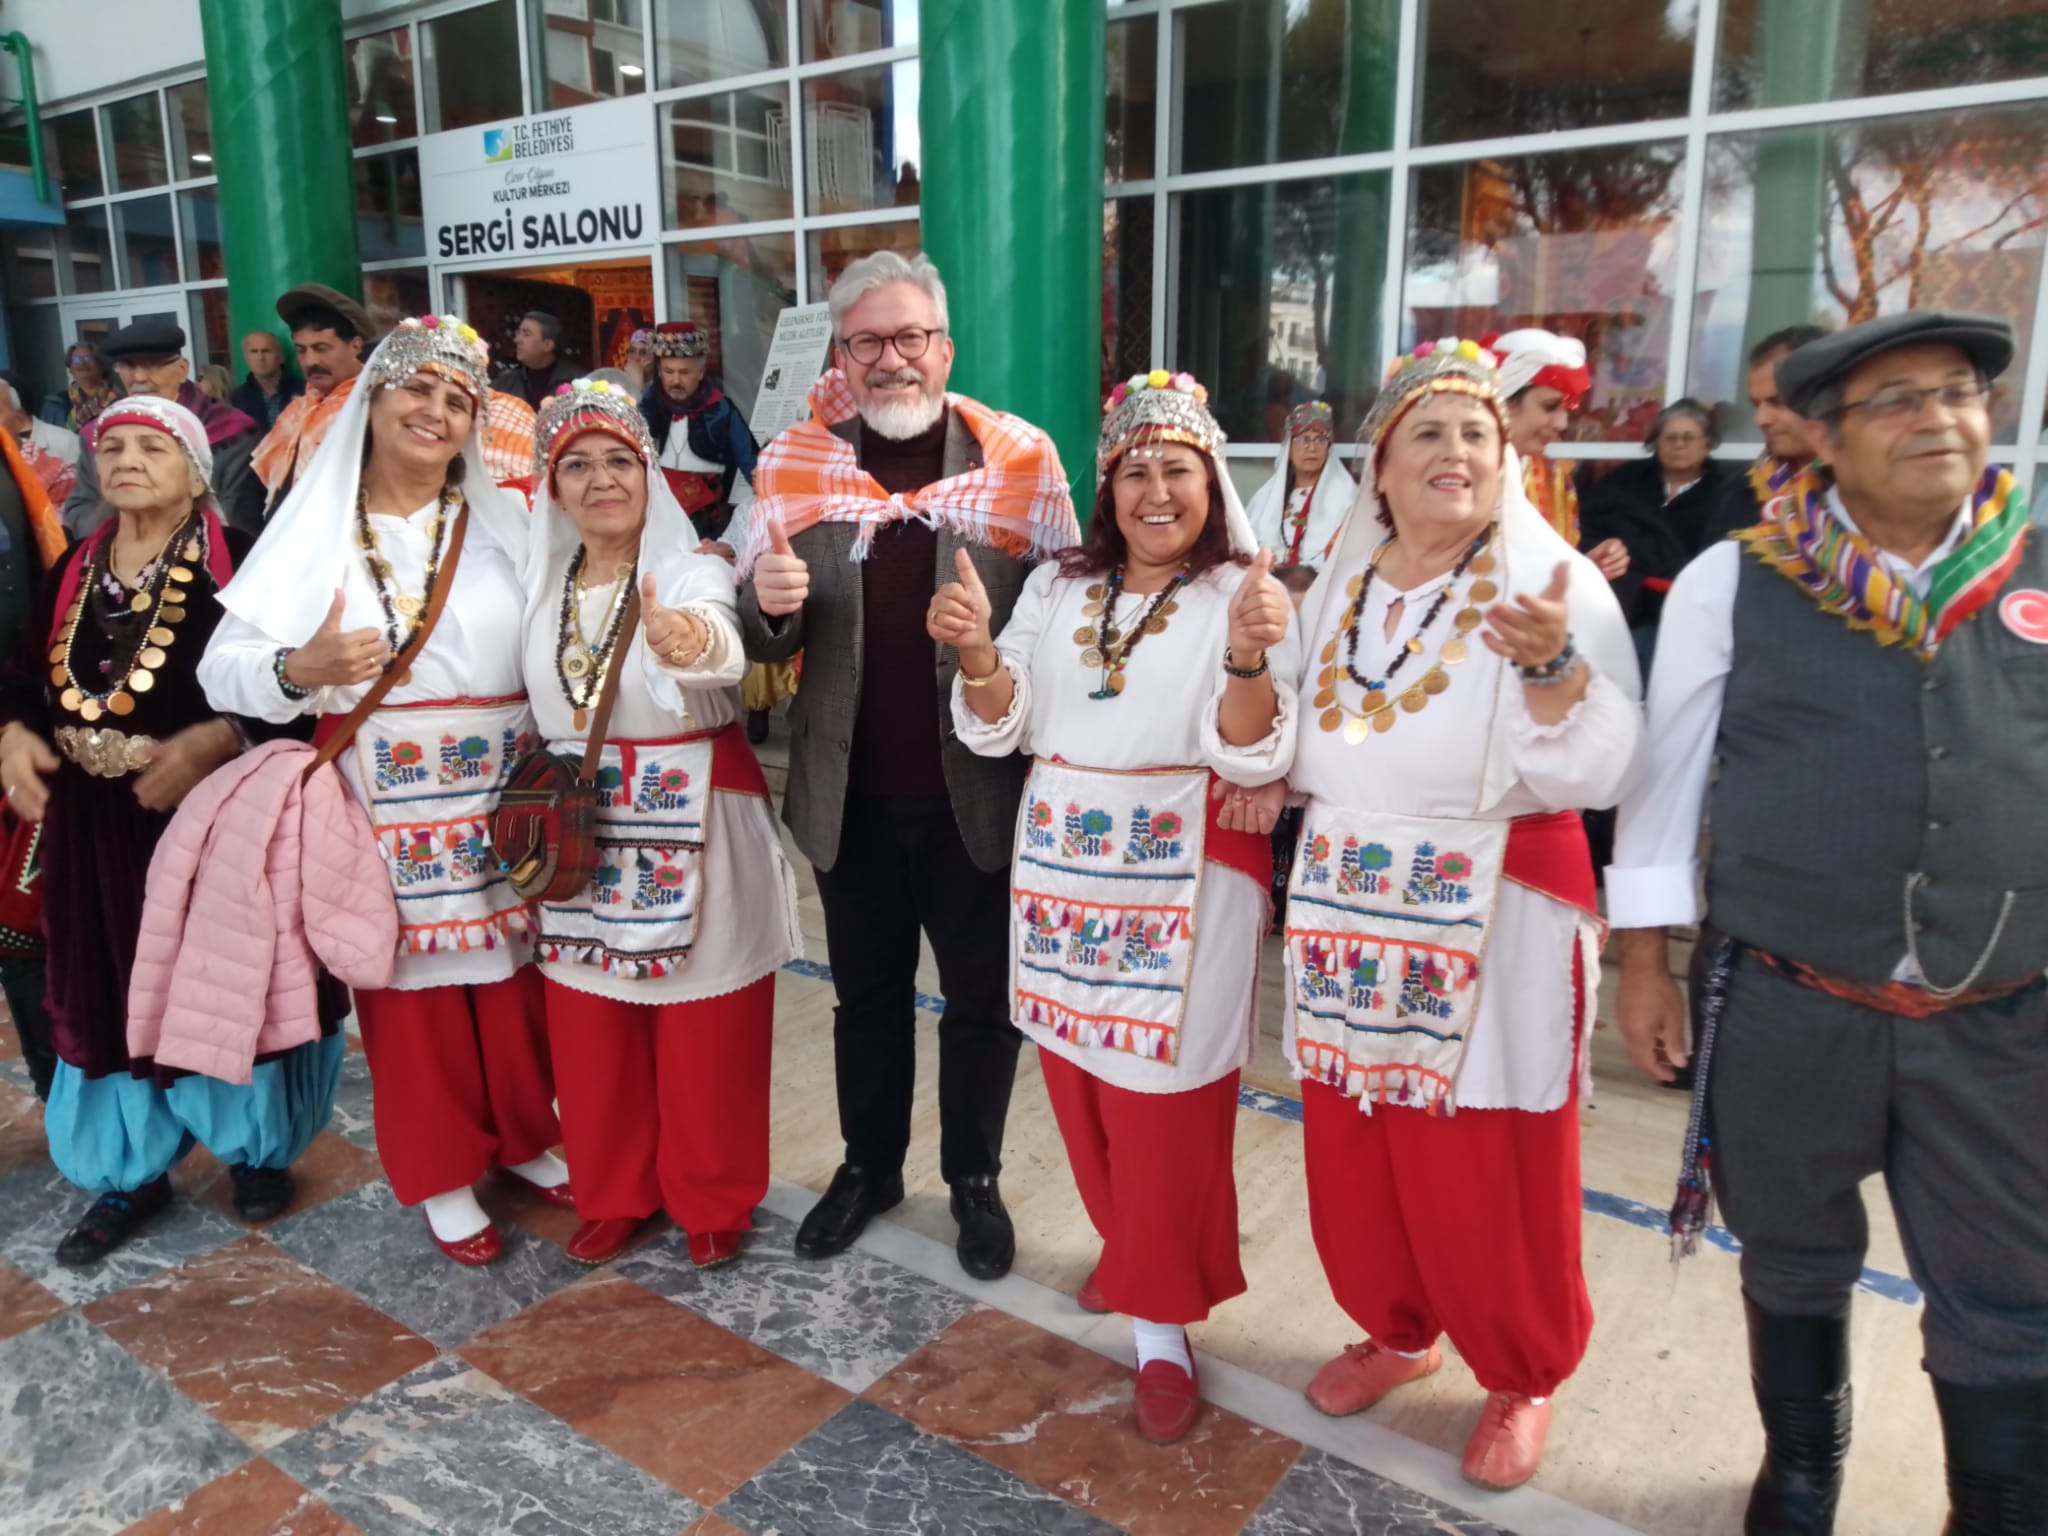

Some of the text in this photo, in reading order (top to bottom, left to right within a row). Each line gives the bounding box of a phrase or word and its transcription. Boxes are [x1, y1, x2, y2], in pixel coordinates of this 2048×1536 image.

[513, 124, 530, 142] T.C.
[438, 203, 643, 258] SERGİ SALONU
